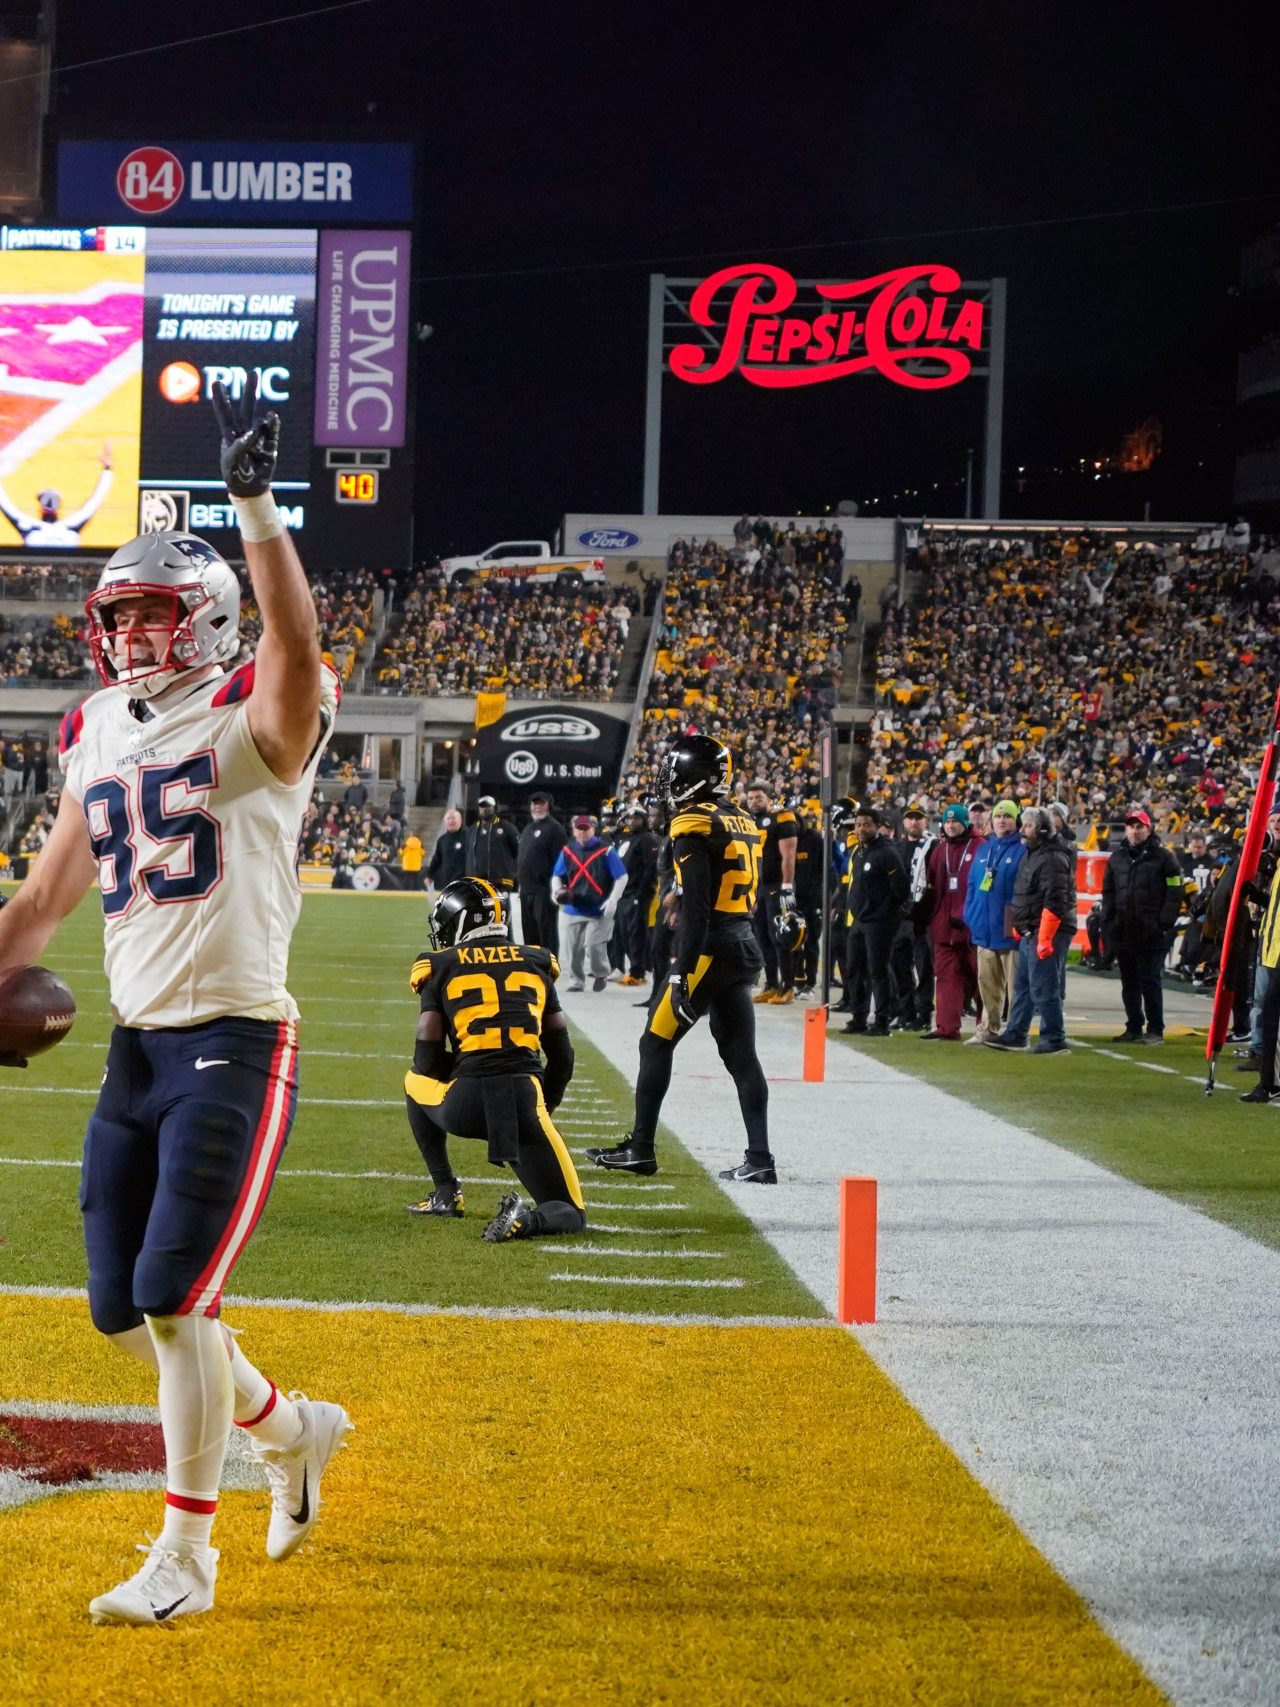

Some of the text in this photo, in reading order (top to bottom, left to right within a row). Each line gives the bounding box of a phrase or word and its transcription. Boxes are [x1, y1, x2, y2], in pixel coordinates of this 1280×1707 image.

[124, 161, 353, 201] 84 LUMBER
[7, 229, 82, 250] PATRIOTS
[114, 236, 137, 250] 14
[161, 293, 296, 314] TONIGHT'S GAME
[156, 319, 299, 342] IS PRESENTED BY
[327, 250, 343, 431] LIFE CHANGING MEDICINE
[346, 246, 398, 432] UPMC
[203, 365, 290, 401] PNC
[339, 474, 375, 500] 40
[190, 504, 304, 529] BETM
[588, 532, 629, 549] Ford
[574, 764, 602, 777] Steel
[83, 748, 223, 919] 85
[457, 945, 525, 965] KAZEE
[446, 970, 547, 1053] 23
